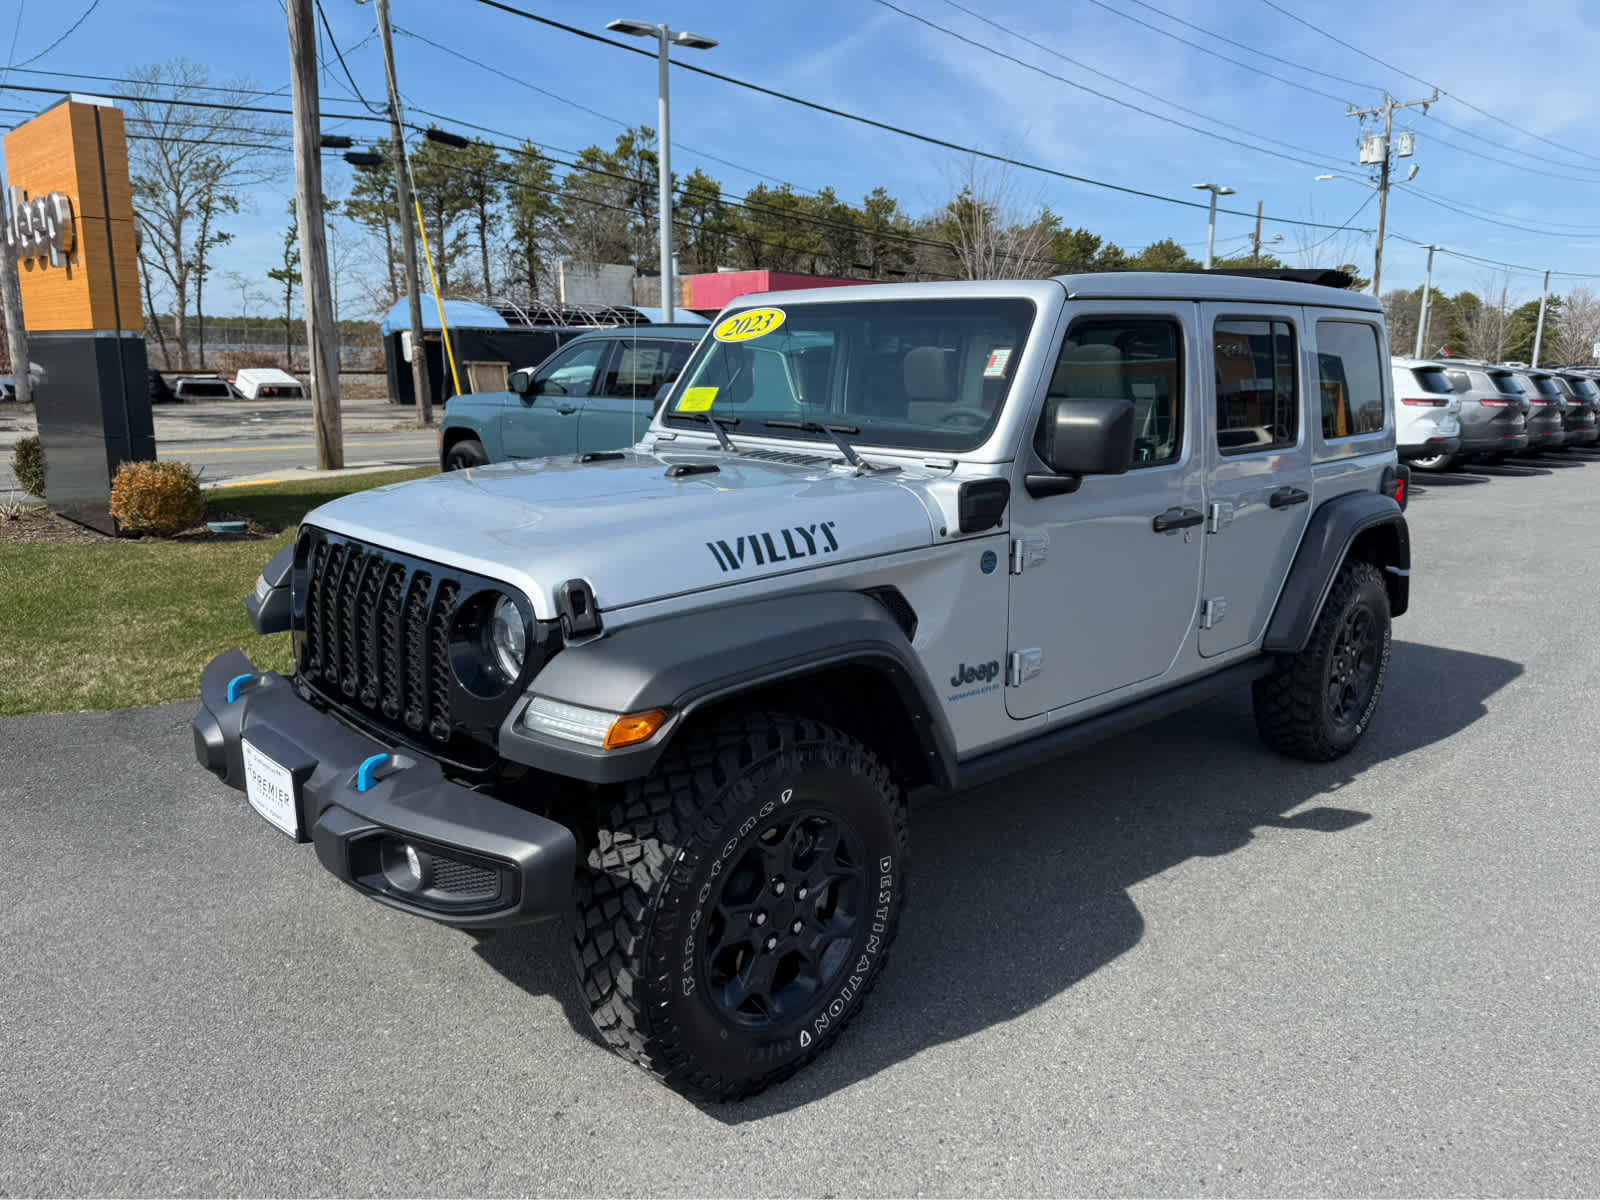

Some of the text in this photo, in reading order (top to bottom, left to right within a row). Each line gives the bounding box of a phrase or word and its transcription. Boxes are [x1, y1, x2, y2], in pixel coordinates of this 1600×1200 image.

[723, 313, 775, 337] 2023
[705, 521, 839, 572] WILLYS
[950, 660, 1000, 687] Jeep
[814, 855, 892, 1035] DESTINATION
